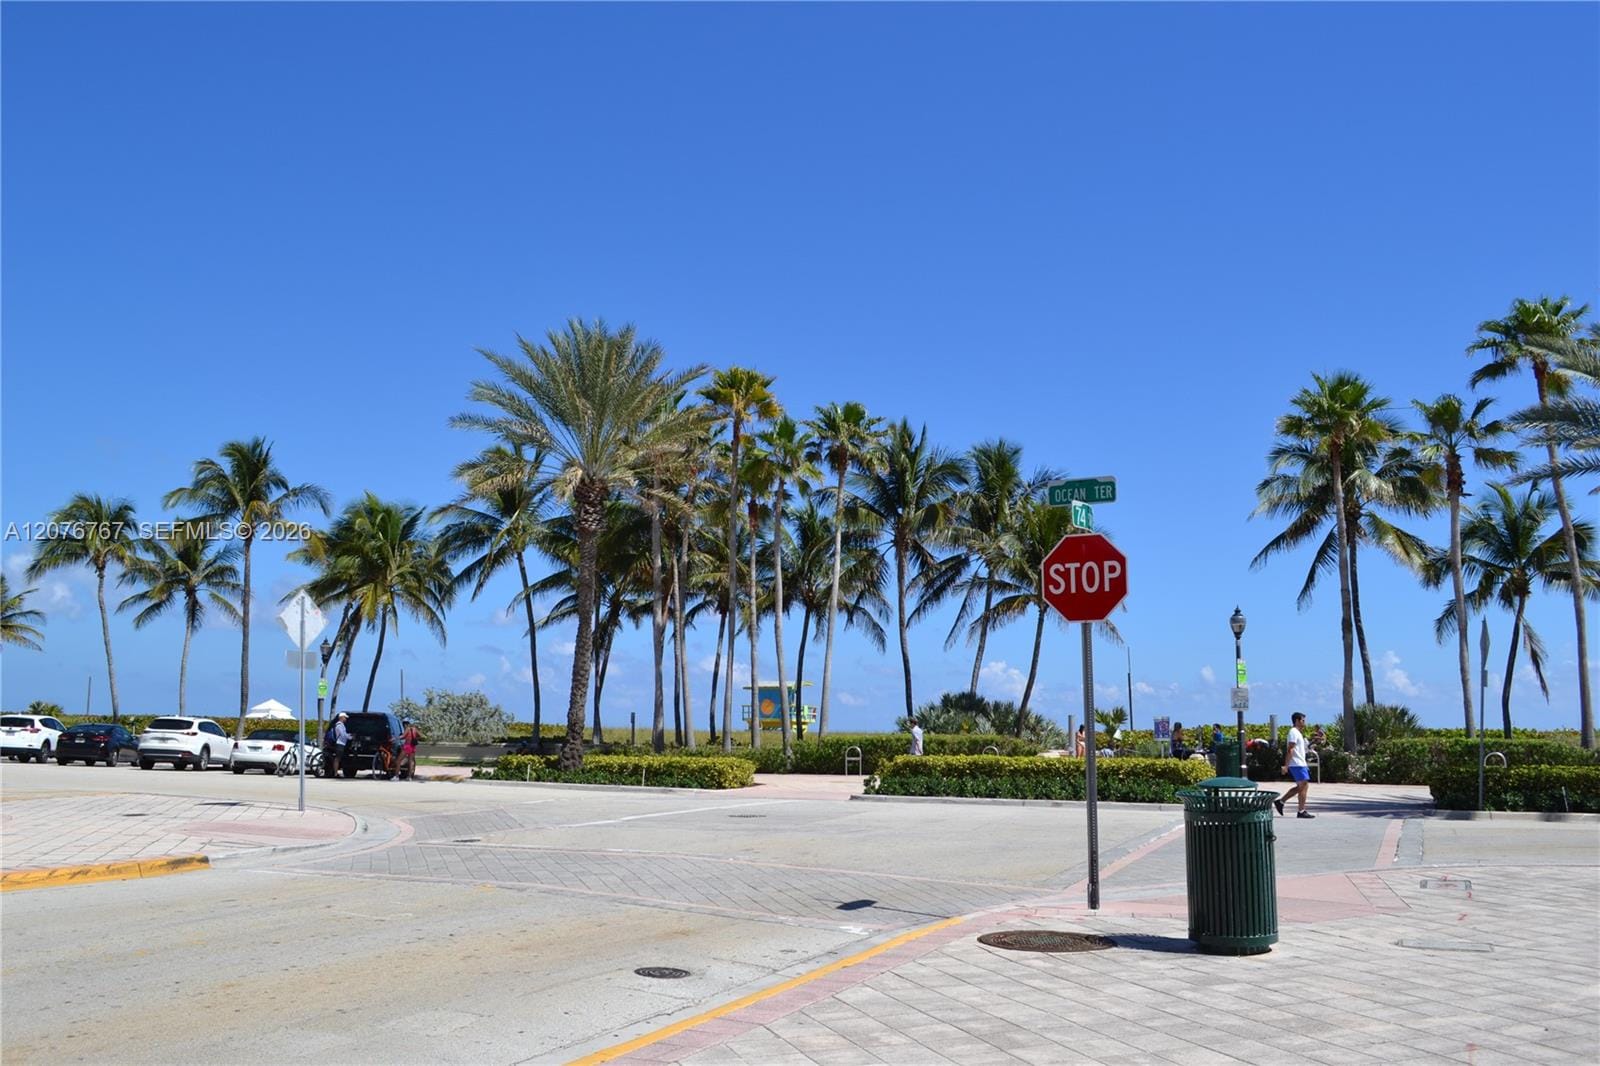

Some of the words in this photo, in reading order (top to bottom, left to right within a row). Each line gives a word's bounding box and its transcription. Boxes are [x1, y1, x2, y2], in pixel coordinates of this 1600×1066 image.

[1055, 487, 1086, 502] OCEAN
[1094, 485, 1113, 499] TER
[1075, 506, 1086, 528] 74
[1048, 560, 1122, 595] STOP
